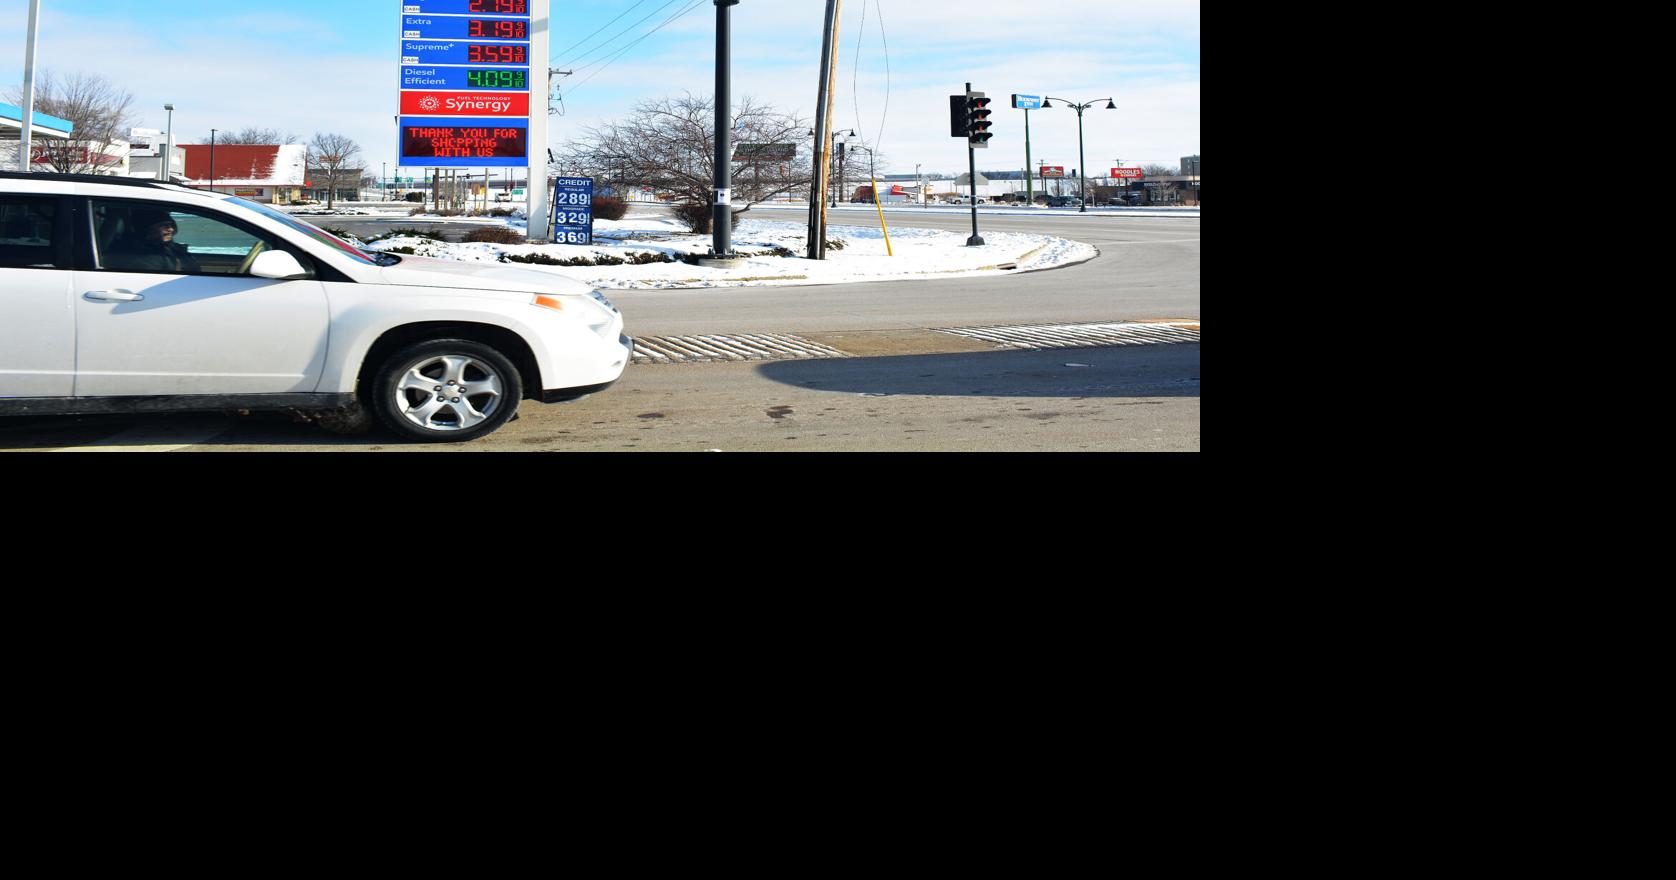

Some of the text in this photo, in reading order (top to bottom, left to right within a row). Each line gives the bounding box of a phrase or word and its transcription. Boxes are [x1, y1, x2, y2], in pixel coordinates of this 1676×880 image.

[469, 20, 513, 38] 3.19
[469, 45, 513, 63] 3.59
[404, 77, 446, 85] Efficient
[468, 71, 512, 88] 4.09
[445, 98, 511, 112] Synergy
[410, 128, 517, 138] THANK YOU FOR
[434, 148, 494, 157] WITH US
